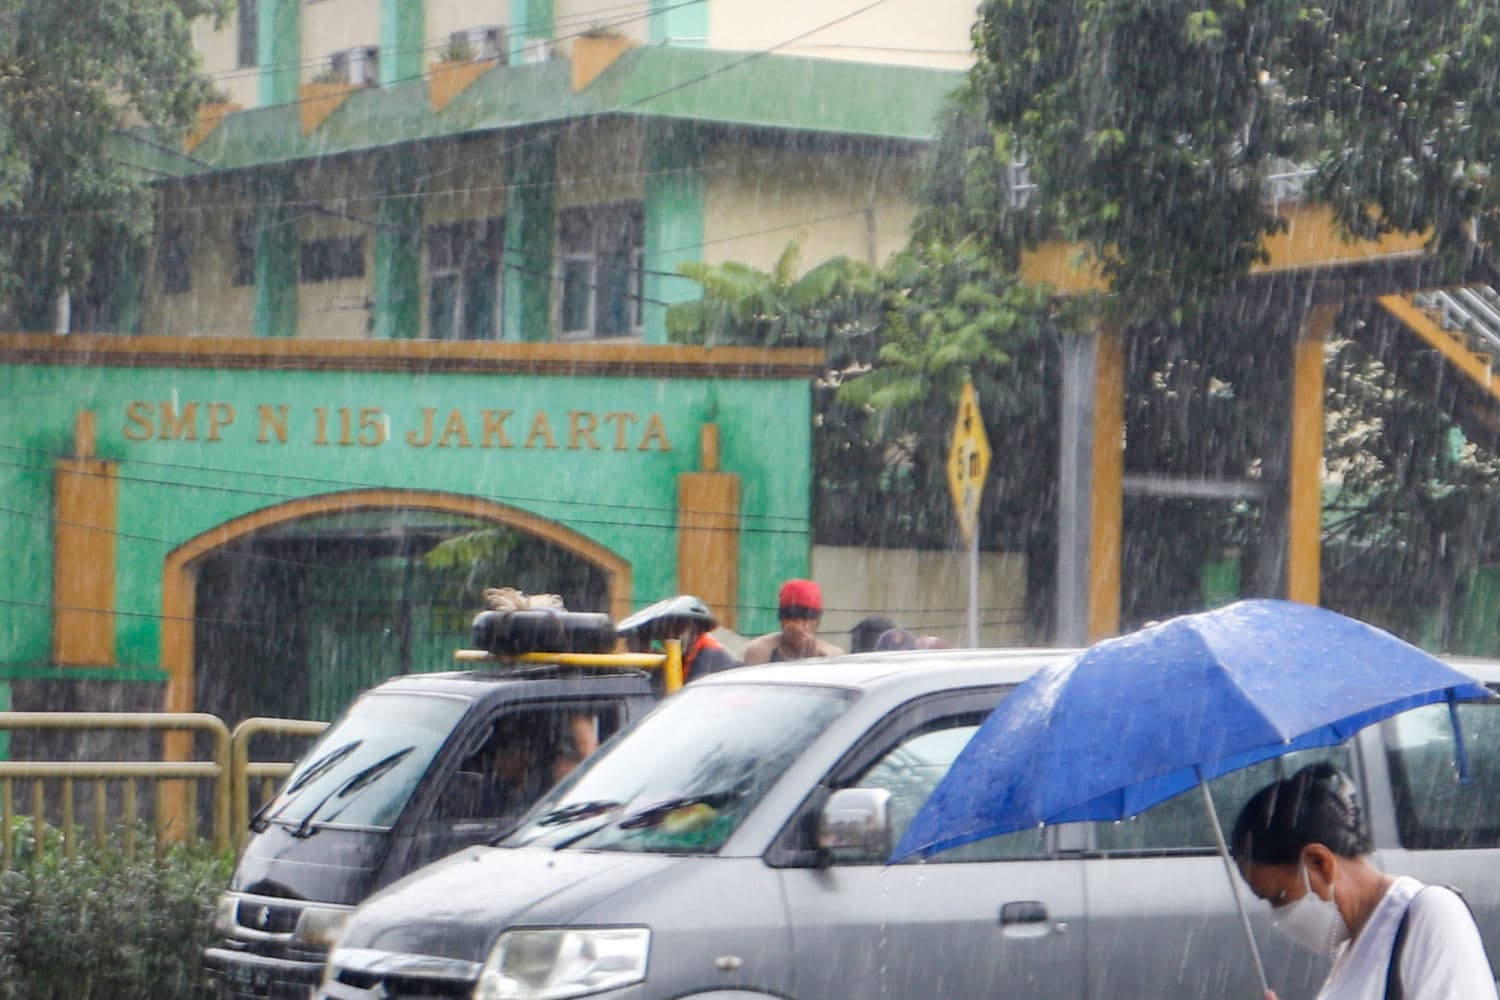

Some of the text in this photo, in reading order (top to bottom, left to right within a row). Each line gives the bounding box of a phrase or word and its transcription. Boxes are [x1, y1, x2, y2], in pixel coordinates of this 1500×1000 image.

[123, 401, 672, 452] SMP N 115 JAKARTA
